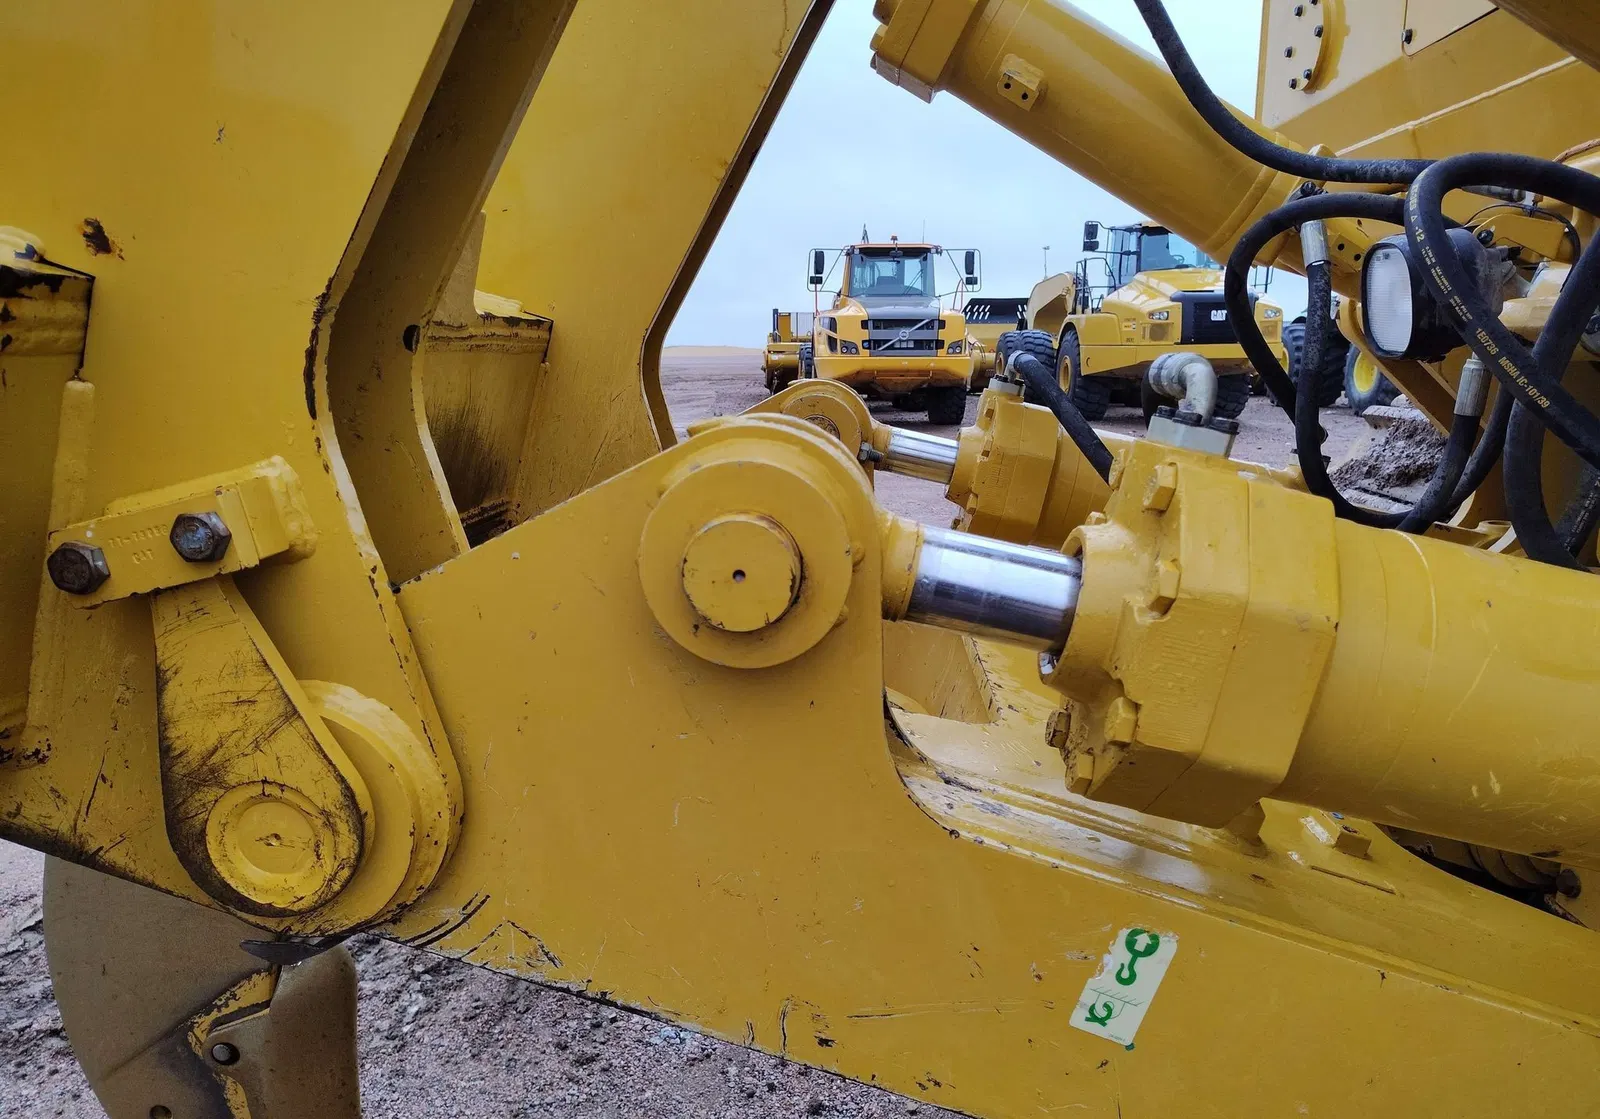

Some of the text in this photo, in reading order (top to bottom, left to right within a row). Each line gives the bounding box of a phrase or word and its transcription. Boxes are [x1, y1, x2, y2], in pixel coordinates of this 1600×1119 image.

[1211, 310, 1227, 321] CAT
[1476, 328, 1551, 408] 1E0736 MSHA IC-101/39
